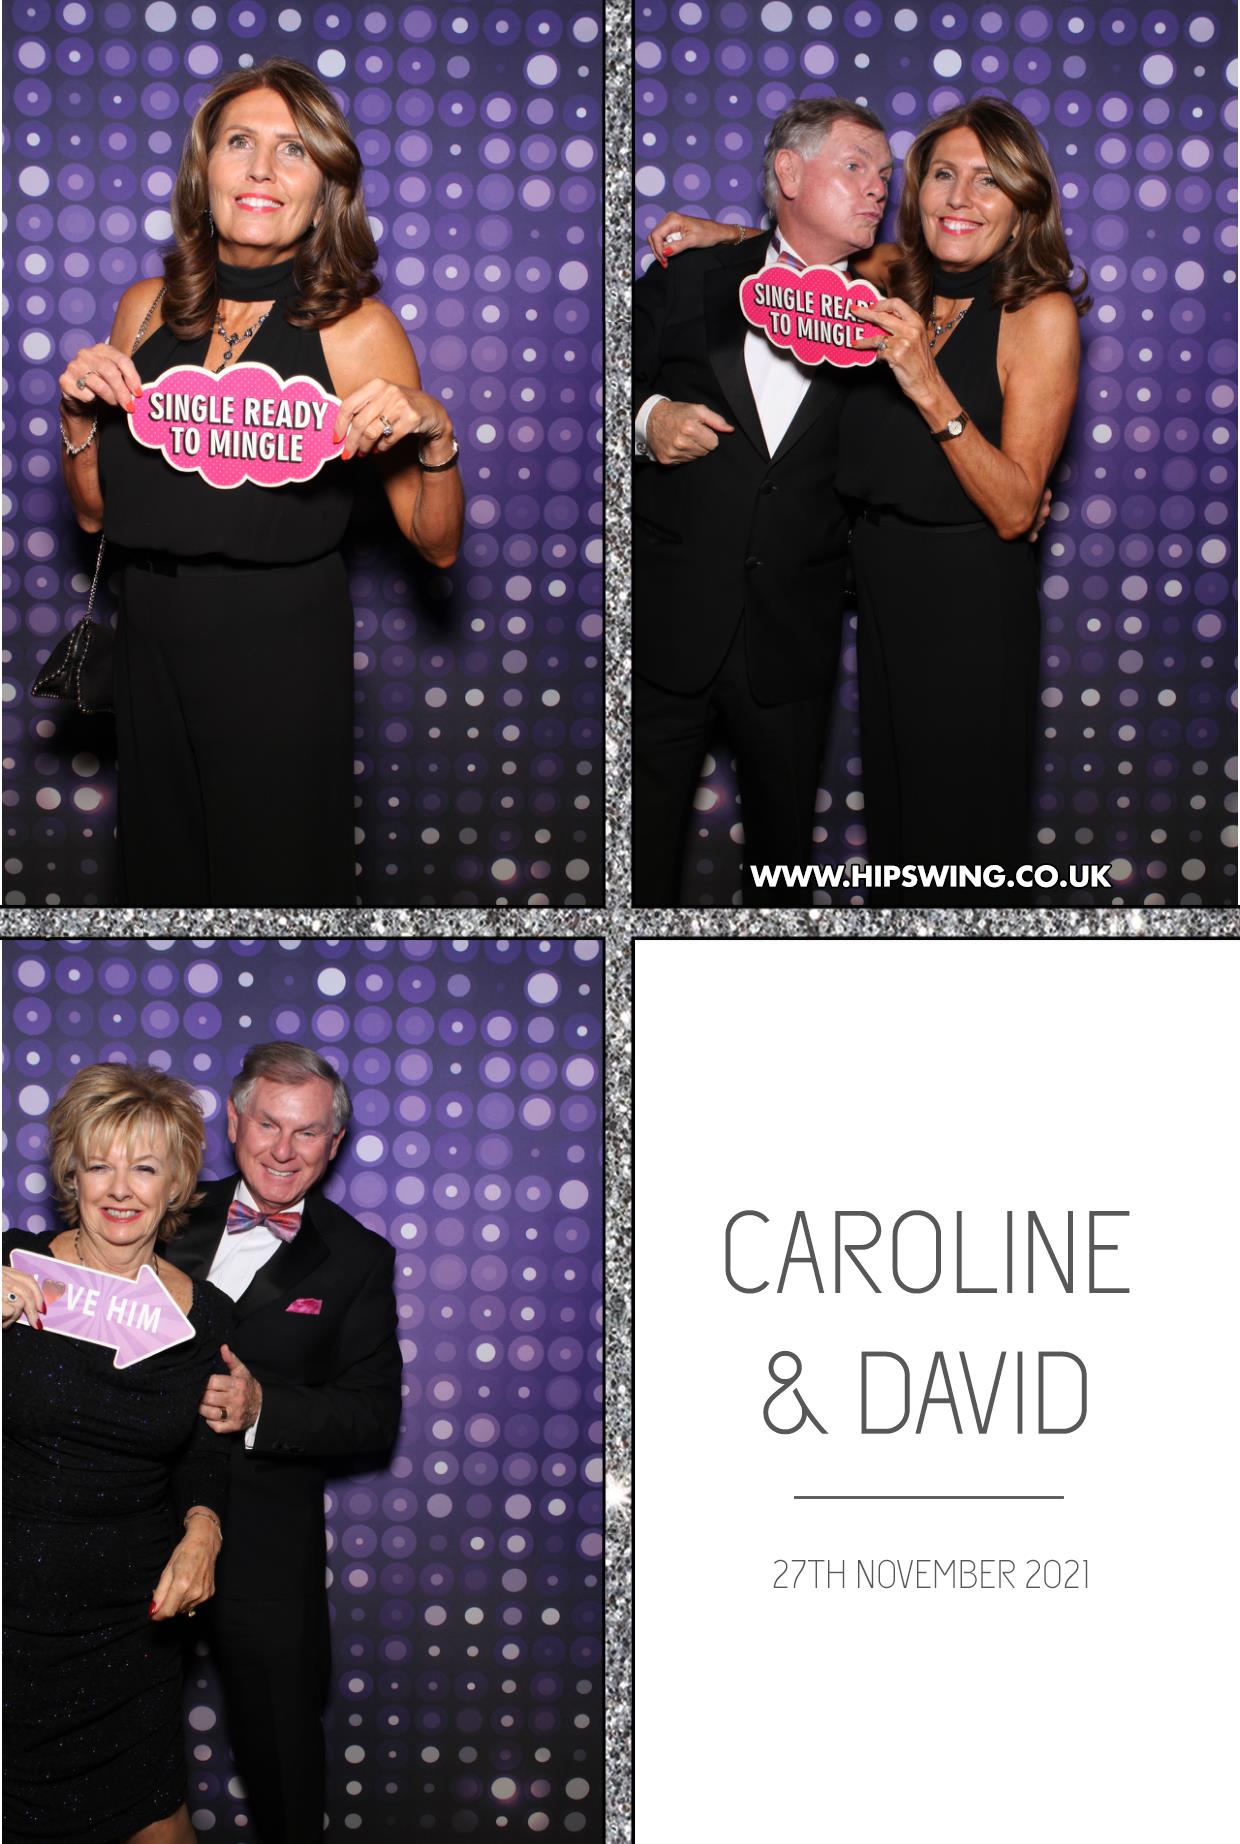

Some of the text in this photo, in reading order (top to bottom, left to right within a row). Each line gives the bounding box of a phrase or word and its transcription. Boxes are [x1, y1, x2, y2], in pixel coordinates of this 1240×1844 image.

[754, 282, 815, 315] SINGLE
[770, 311, 864, 348] TO MINGLE
[149, 391, 329, 431] SINGLE READY
[170, 426, 304, 463] TO MINGLE
[106, 1295, 162, 1334] HIM
